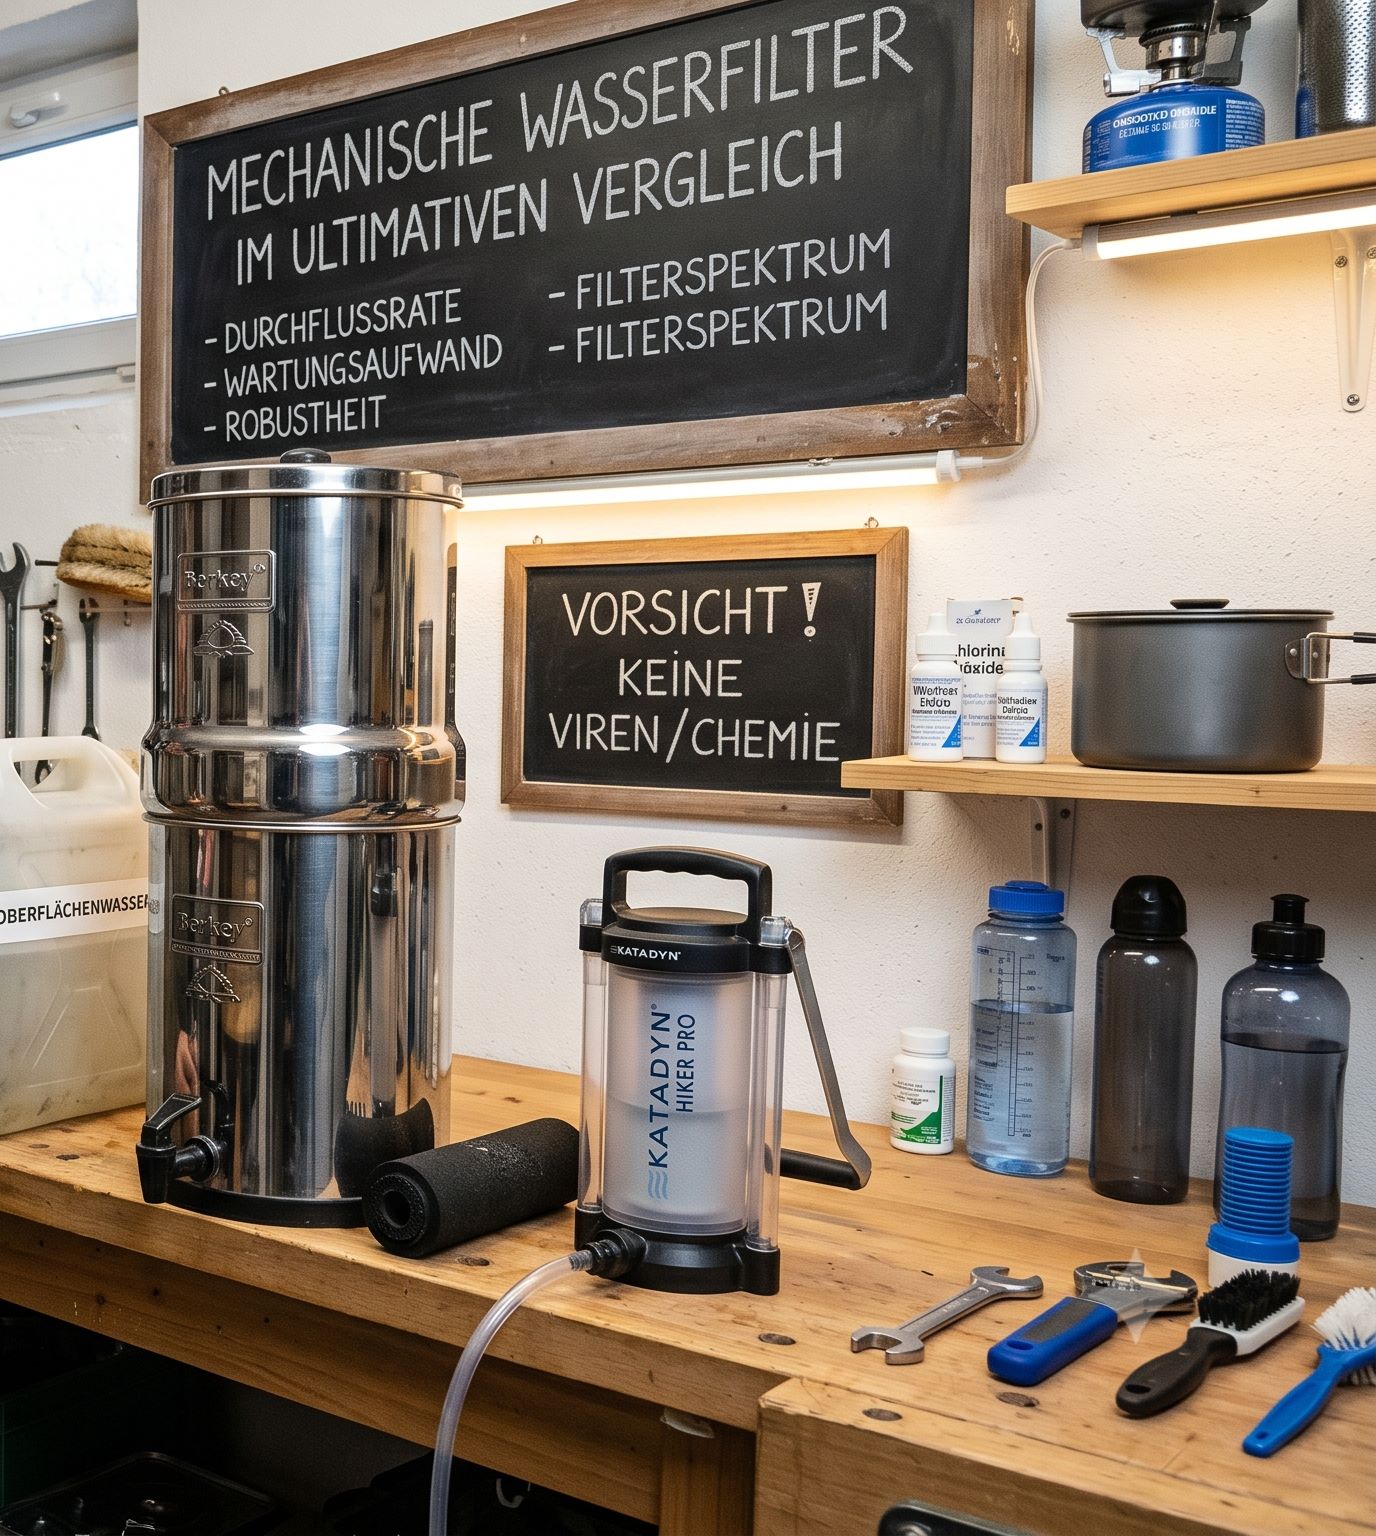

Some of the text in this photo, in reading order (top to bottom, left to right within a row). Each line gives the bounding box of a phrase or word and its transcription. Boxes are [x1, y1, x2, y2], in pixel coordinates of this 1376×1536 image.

[208, 5, 914, 221] MECHANISCHE WASSERFILTER
[238, 120, 843, 286] IM ULTIMATIVEN VERGLEICH
[576, 228, 891, 310] FILTERSPEKTRUM
[225, 287, 462, 354] DURCHFLUSSRATE
[576, 289, 887, 362] FILTERSPEKTRUM
[224, 333, 503, 398] WARTUNGSAUFWAND
[226, 394, 387, 442] ROBUSTHEIT
[561, 585, 789, 637] VORSICHT
[675, 1014, 696, 1113] HIKER PRO
